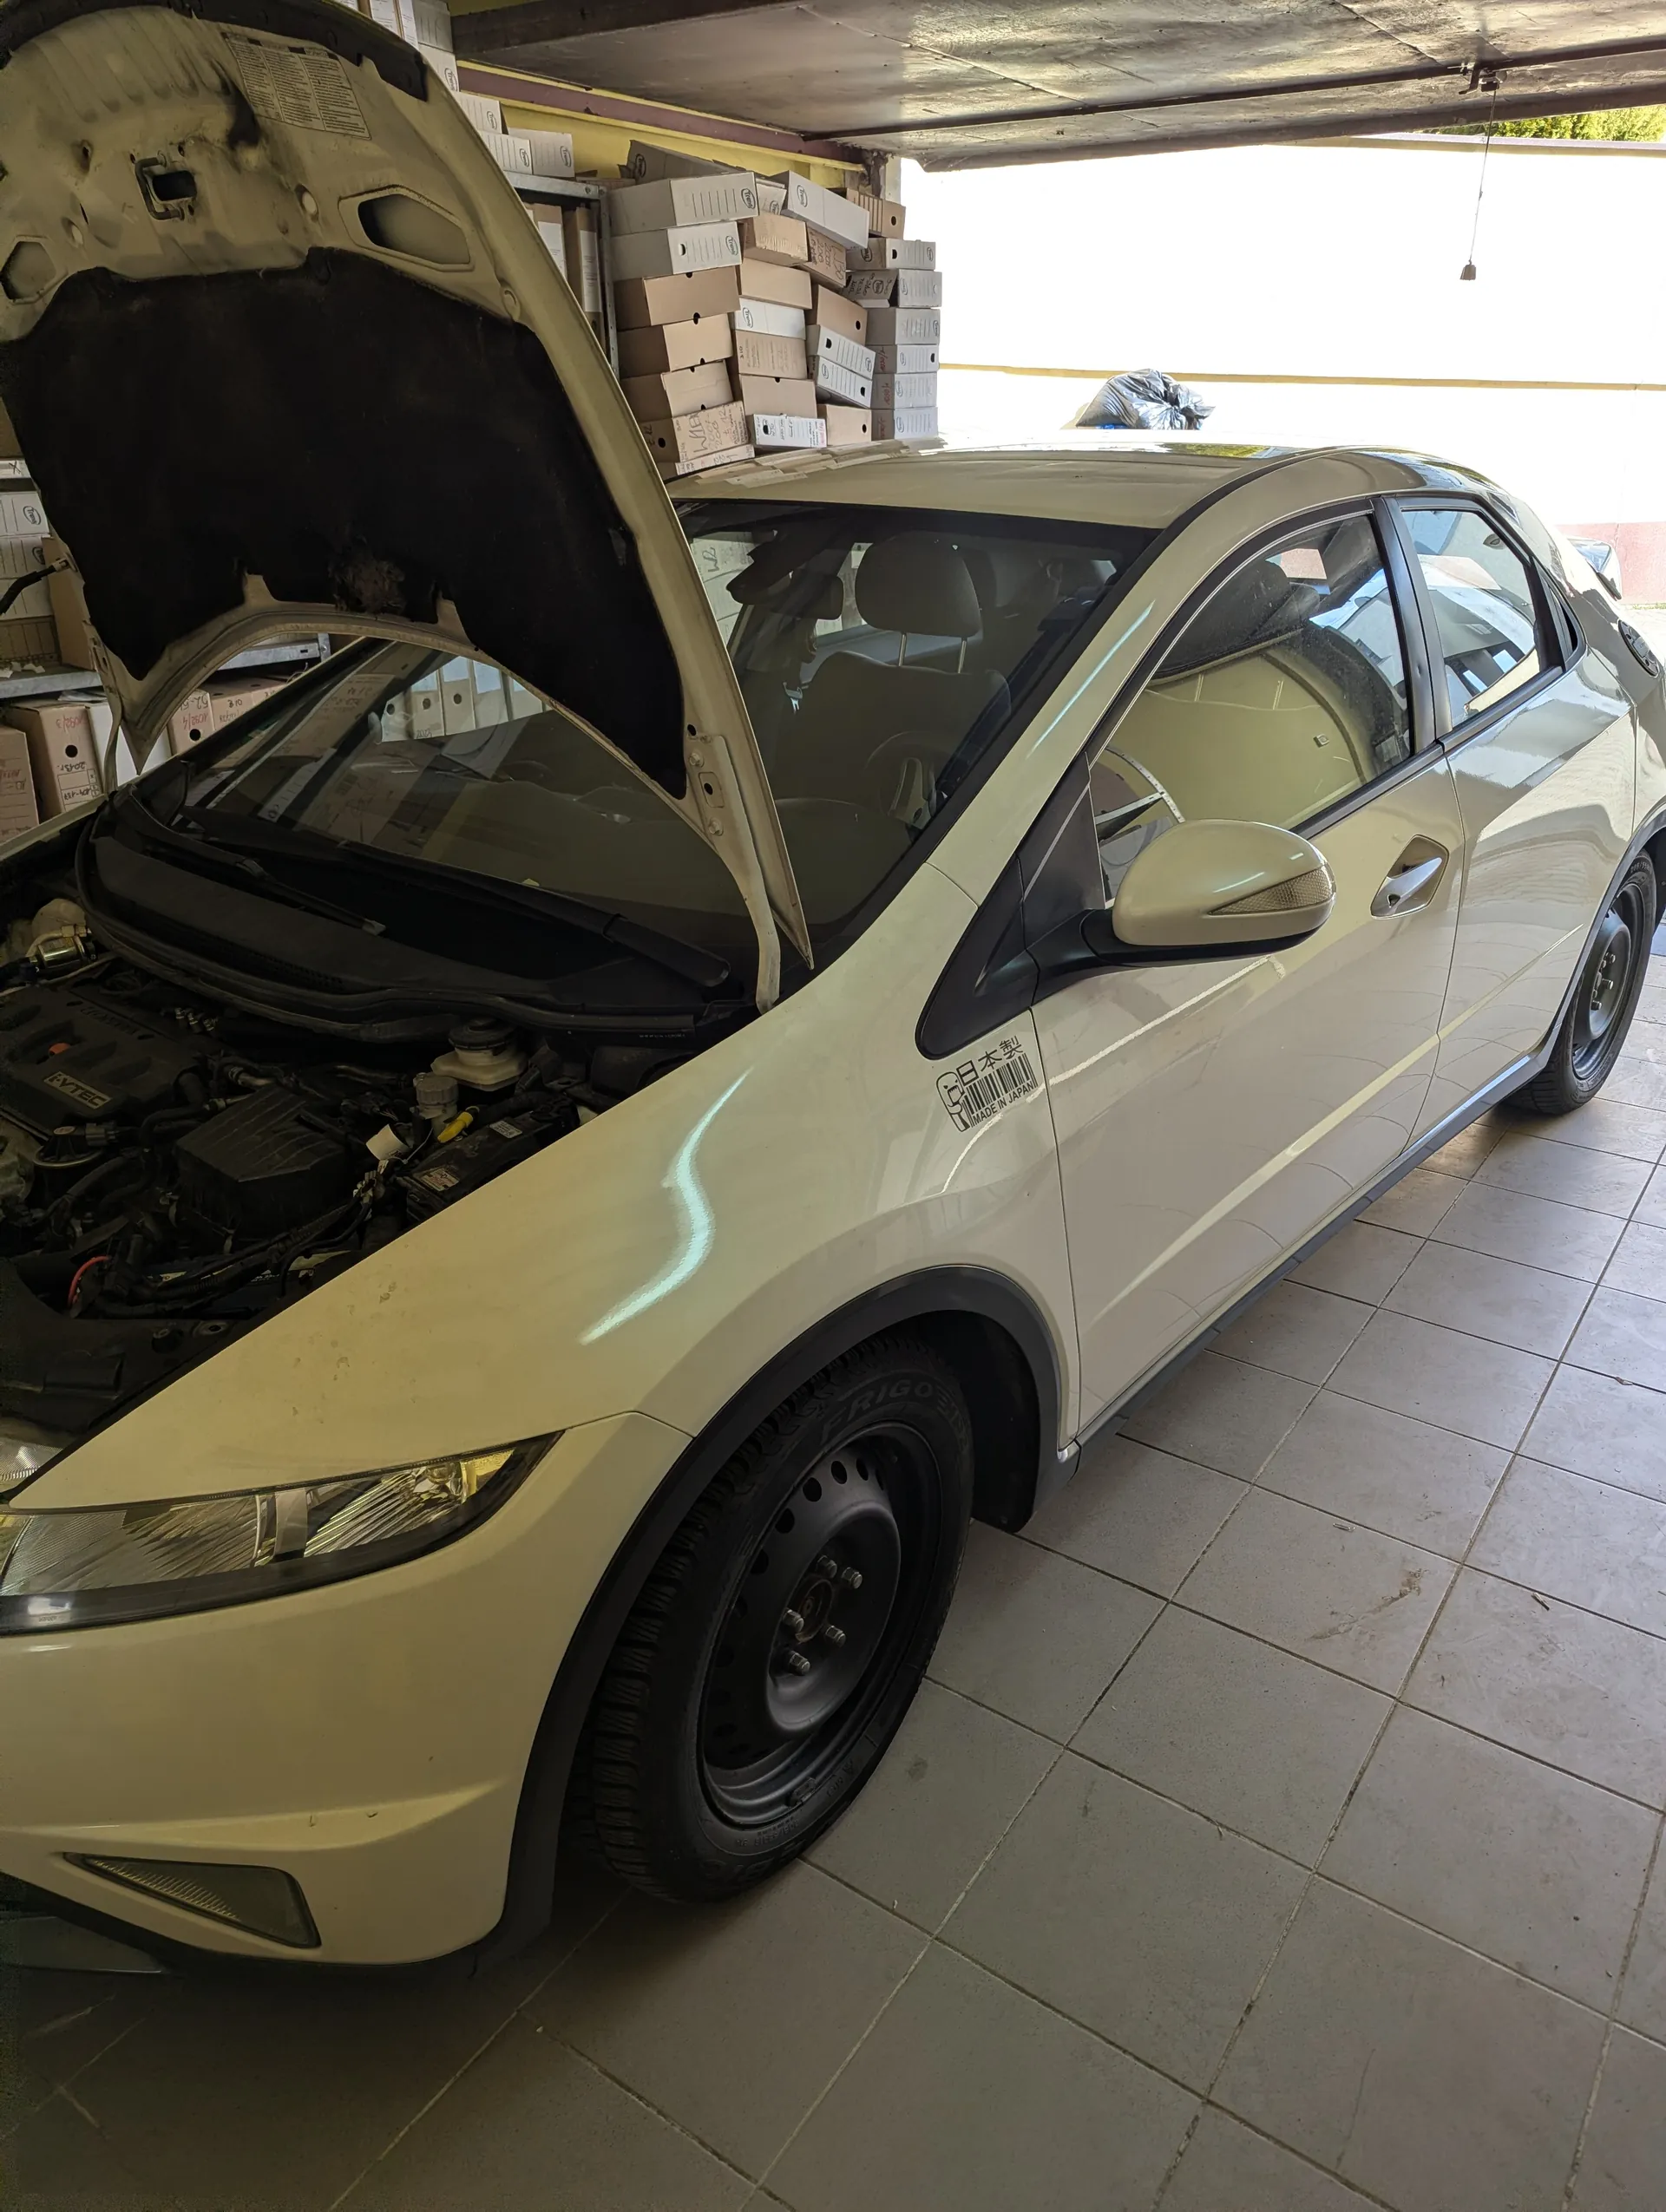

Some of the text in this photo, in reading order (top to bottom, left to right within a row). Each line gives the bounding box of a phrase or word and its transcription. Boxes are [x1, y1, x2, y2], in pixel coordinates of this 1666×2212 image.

[956, 1035, 1024, 1086] 日本製
[973, 1081, 1034, 1126] MADE IN JAPAN
[819, 1379, 934, 1446] FRIGO
